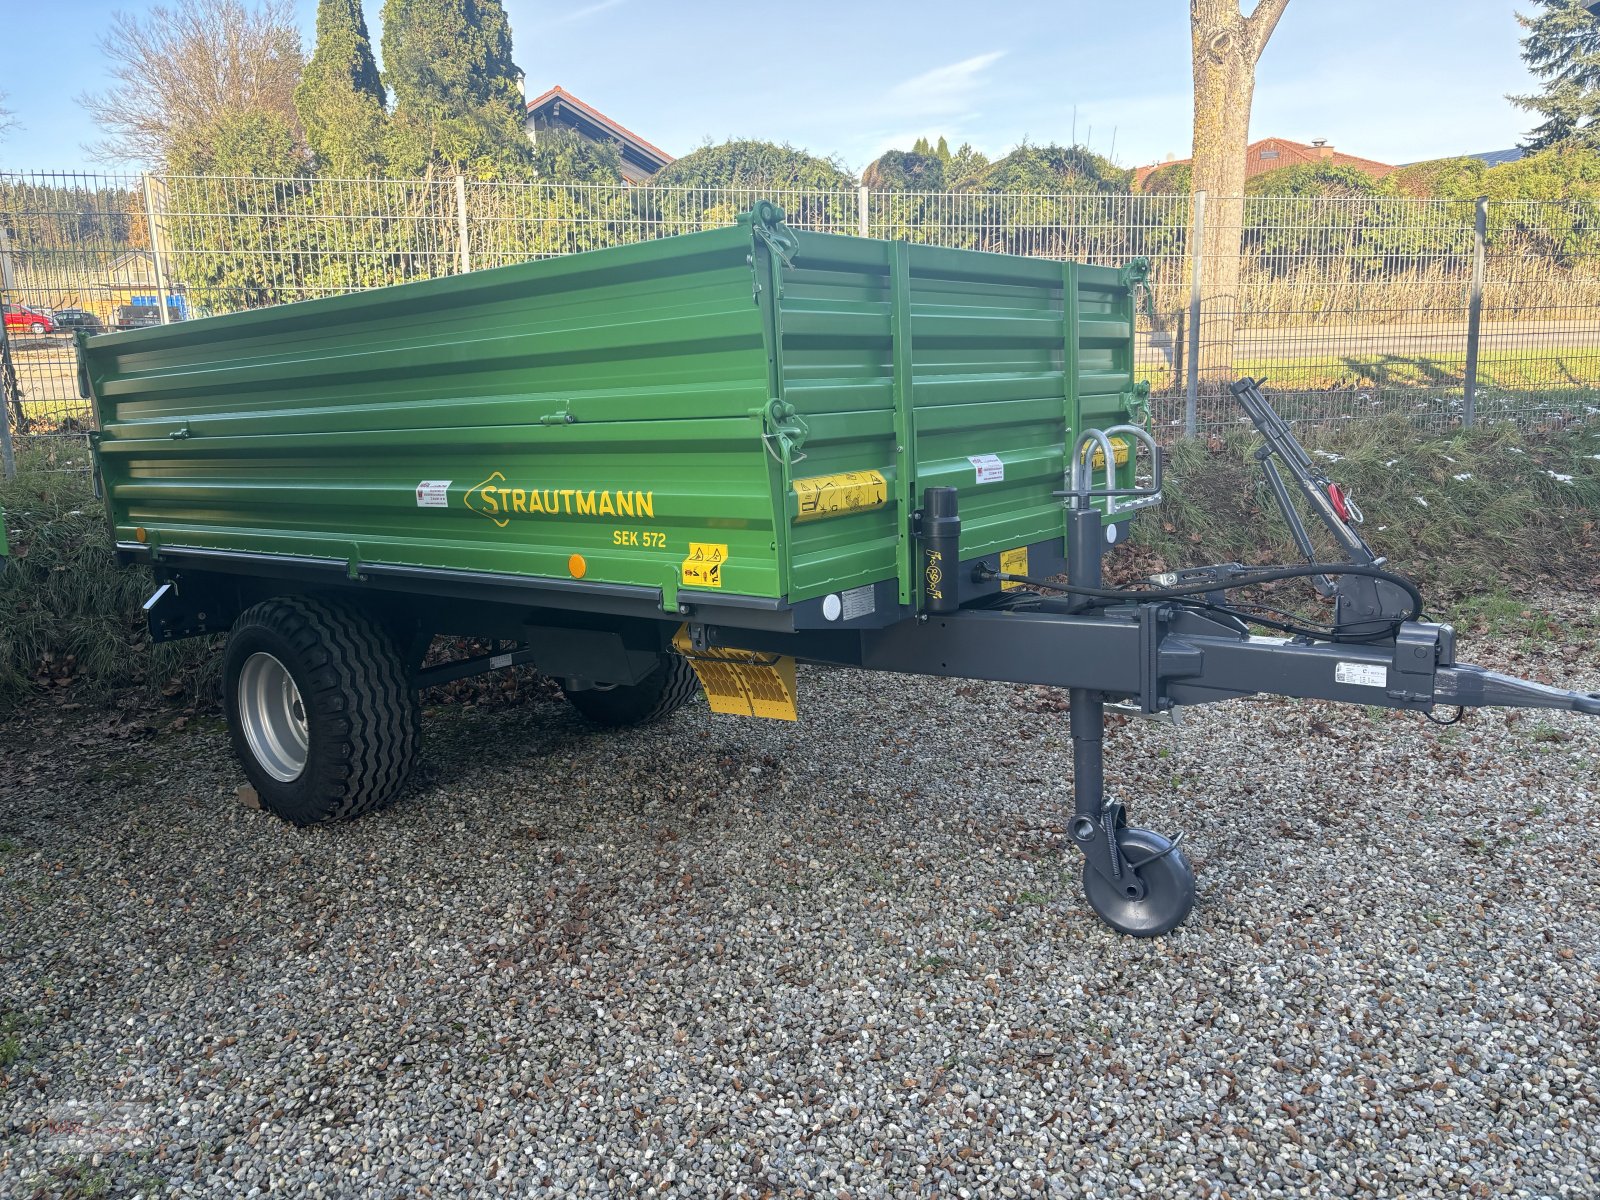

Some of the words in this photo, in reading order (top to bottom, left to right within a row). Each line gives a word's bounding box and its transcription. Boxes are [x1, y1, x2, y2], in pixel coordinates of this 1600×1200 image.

[481, 485, 655, 518] STRAUTMANN
[613, 530, 638, 546] SEK
[642, 531, 667, 548] 572
